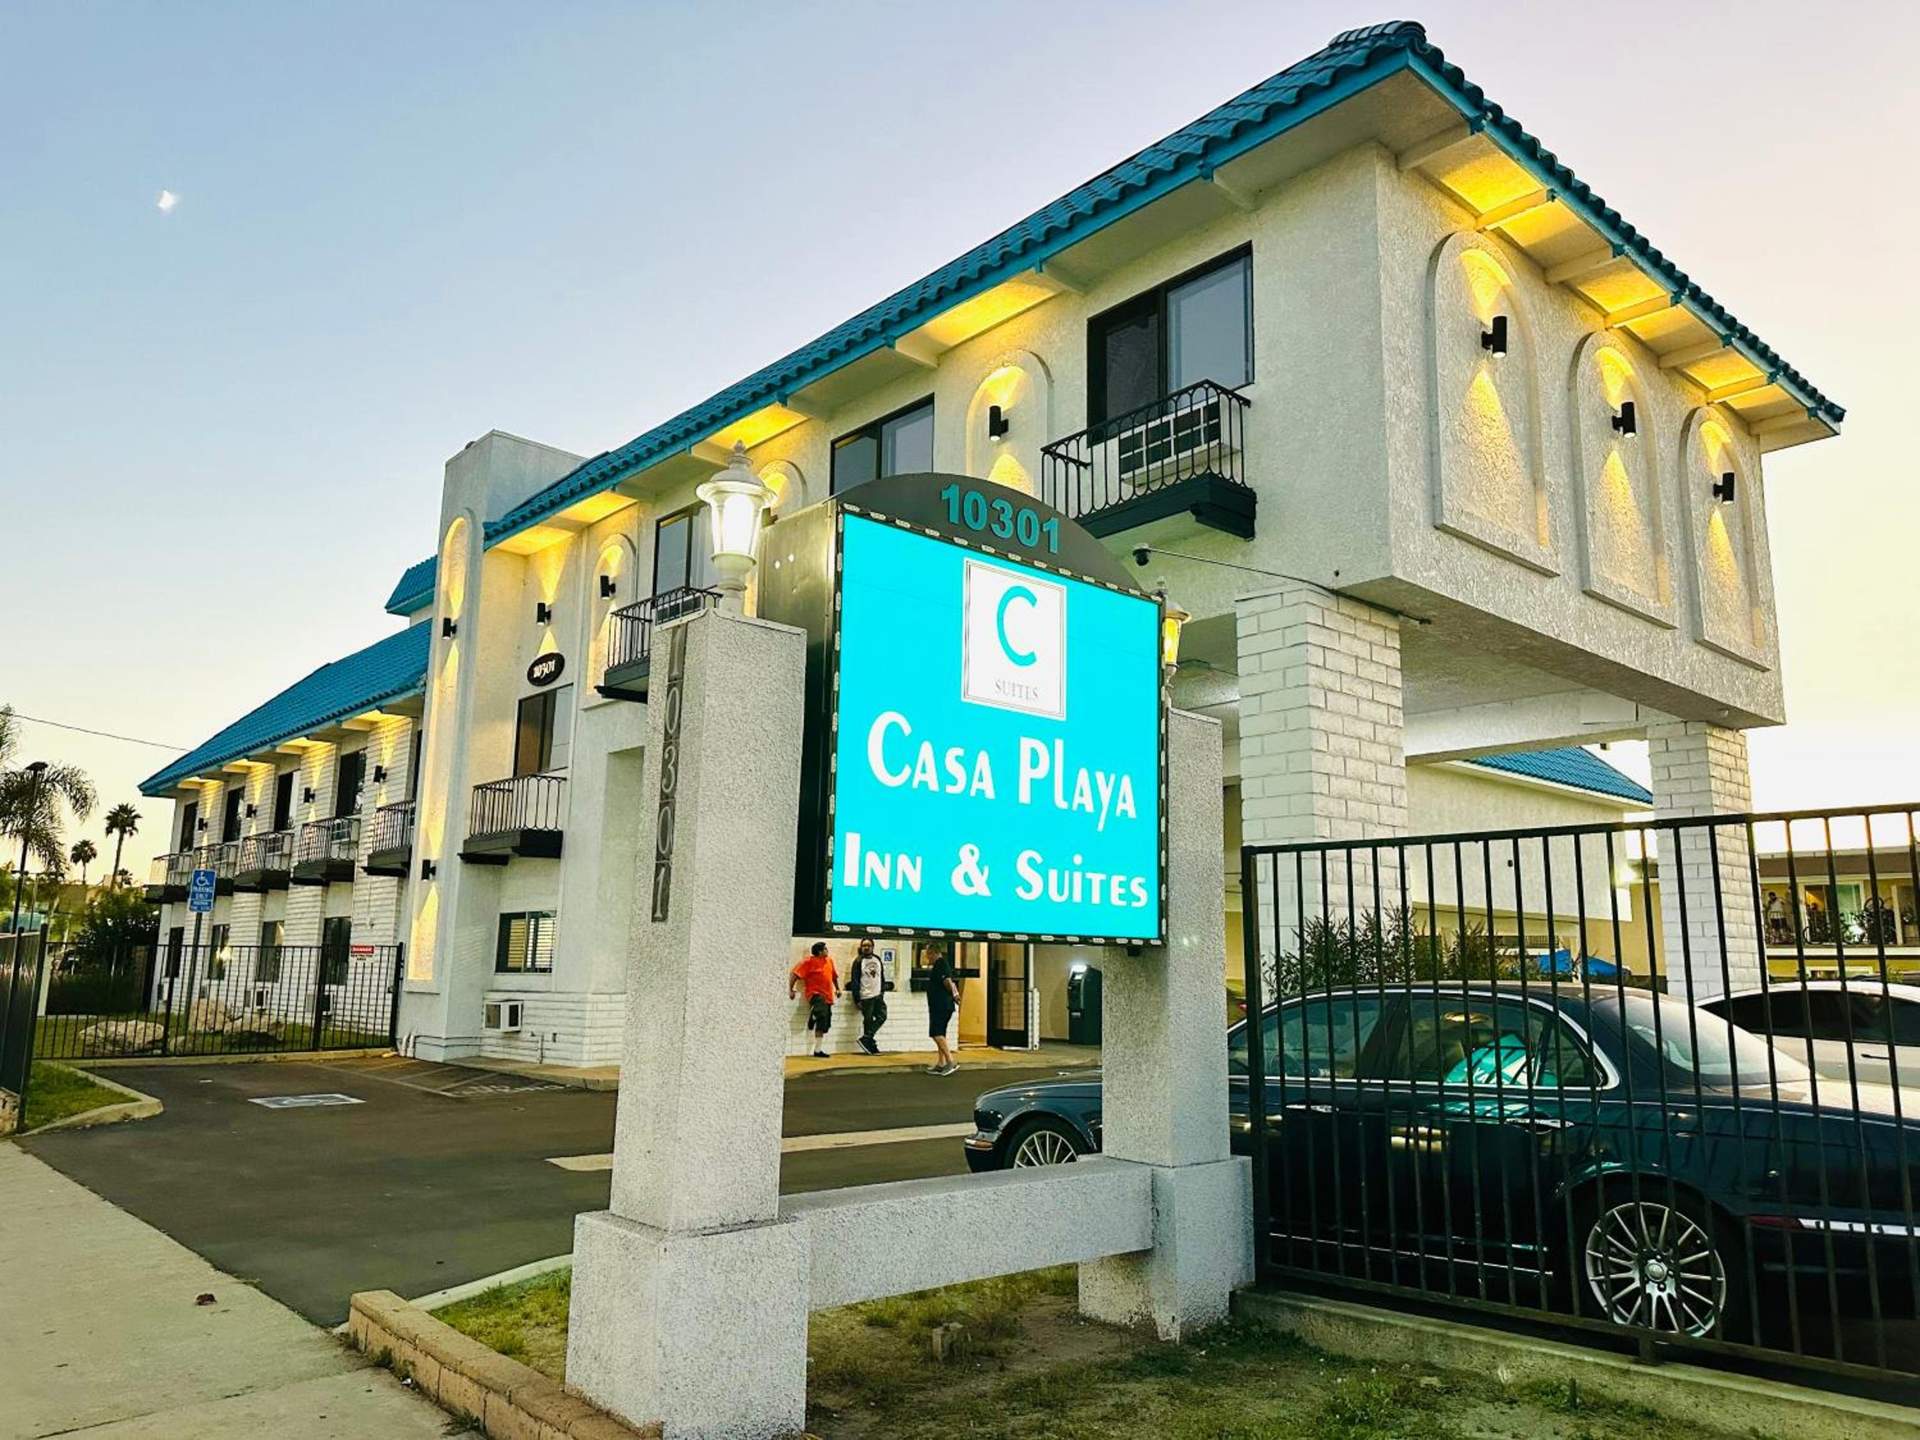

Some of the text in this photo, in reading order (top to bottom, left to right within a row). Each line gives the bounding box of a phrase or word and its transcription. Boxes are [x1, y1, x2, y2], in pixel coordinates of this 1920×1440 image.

[941, 482, 1060, 554] 10301
[996, 585, 1037, 667] C
[994, 679, 1040, 701] SUITES
[654, 624, 687, 918] 10301
[867, 711, 996, 799] CASA
[843, 831, 922, 892] INN
[951, 843, 992, 897] &
